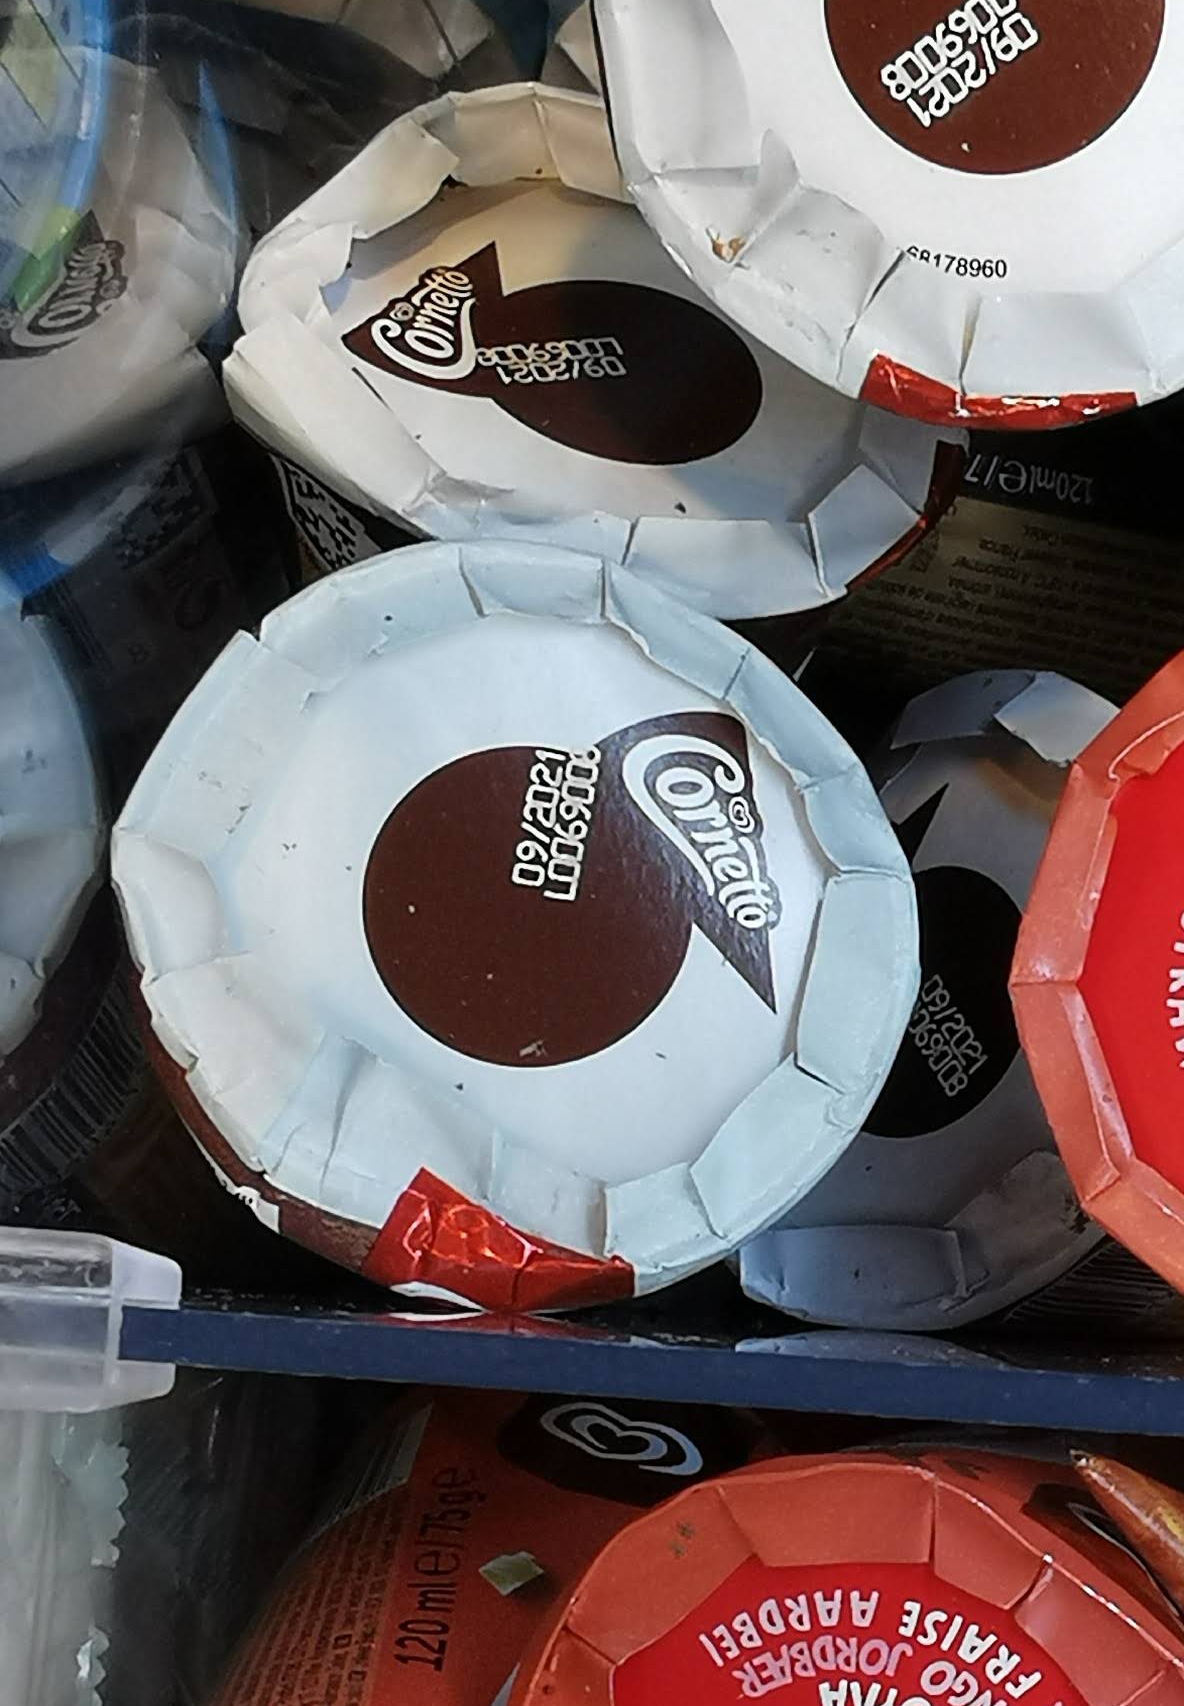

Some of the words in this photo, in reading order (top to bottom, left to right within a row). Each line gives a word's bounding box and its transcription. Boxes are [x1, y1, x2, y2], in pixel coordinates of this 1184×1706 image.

[906, 13, 1038, 127] 09/2021
[370, 264, 478, 381] Cornetto
[510, 747, 567, 889] 09/2021
[622, 735, 782, 930] Cornetto
[389, 1611, 452, 1672] 120
[402, 1572, 458, 1617] ml
[699, 1589, 880, 1668] AARDBEI
[731, 1634, 913, 1699] JORDBÆR
[898, 1598, 1043, 1702] FRAISE
